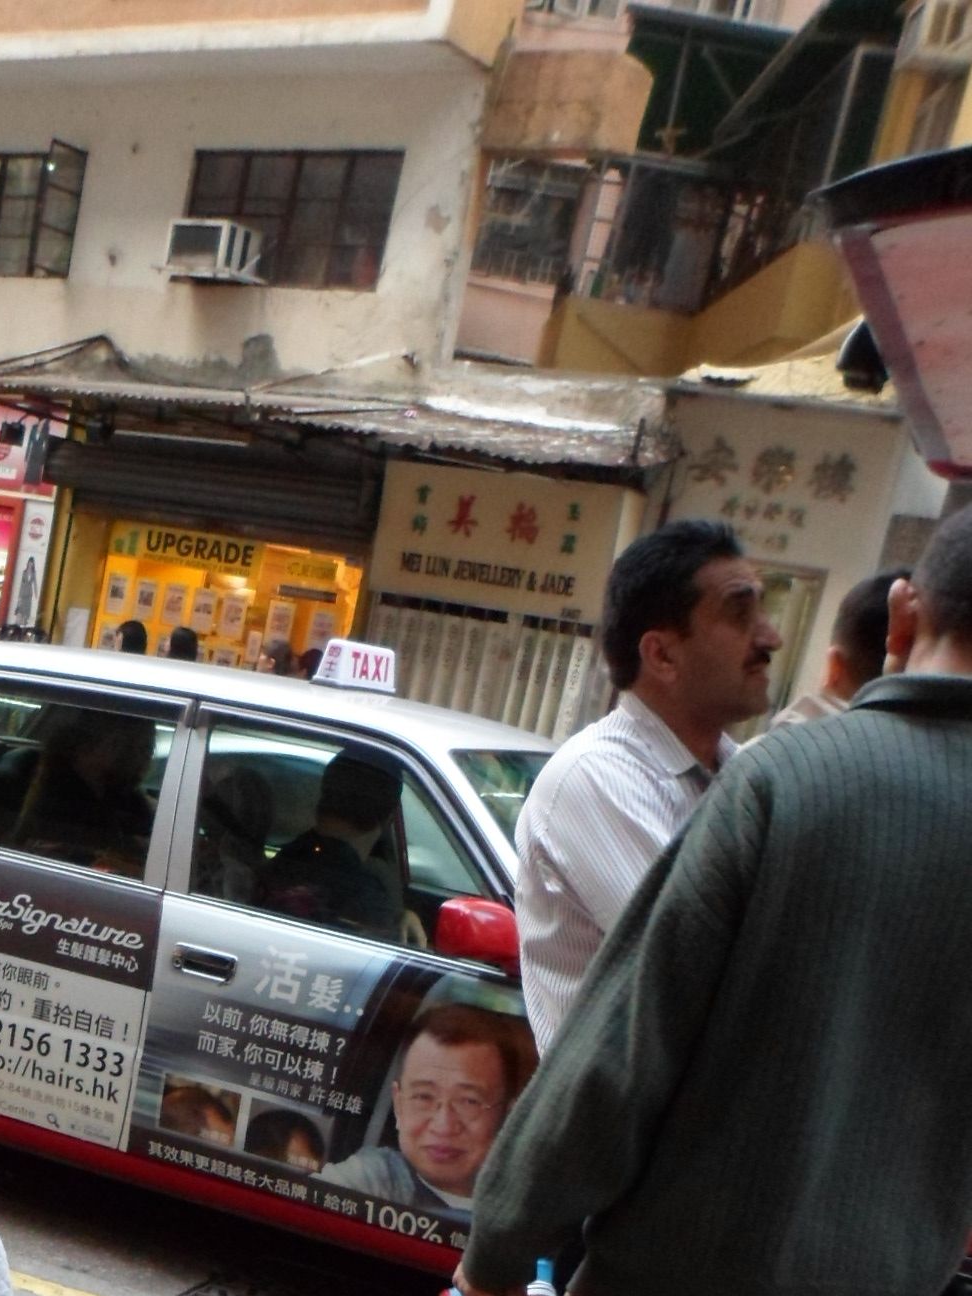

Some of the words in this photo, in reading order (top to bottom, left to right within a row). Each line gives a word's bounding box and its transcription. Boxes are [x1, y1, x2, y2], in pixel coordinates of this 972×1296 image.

[146, 530, 255, 568] UPGRADE
[400, 551, 423, 573] MEI
[425, 555, 451, 576] LUN
[453, 558, 525, 588] JEWELLERY
[527, 571, 537, 591] &
[540, 571, 576, 596] JADE
[352, 651, 390, 683] TAXI
[63, 1038, 125, 1078] 1333
[365, 1200, 443, 1244] 100%
